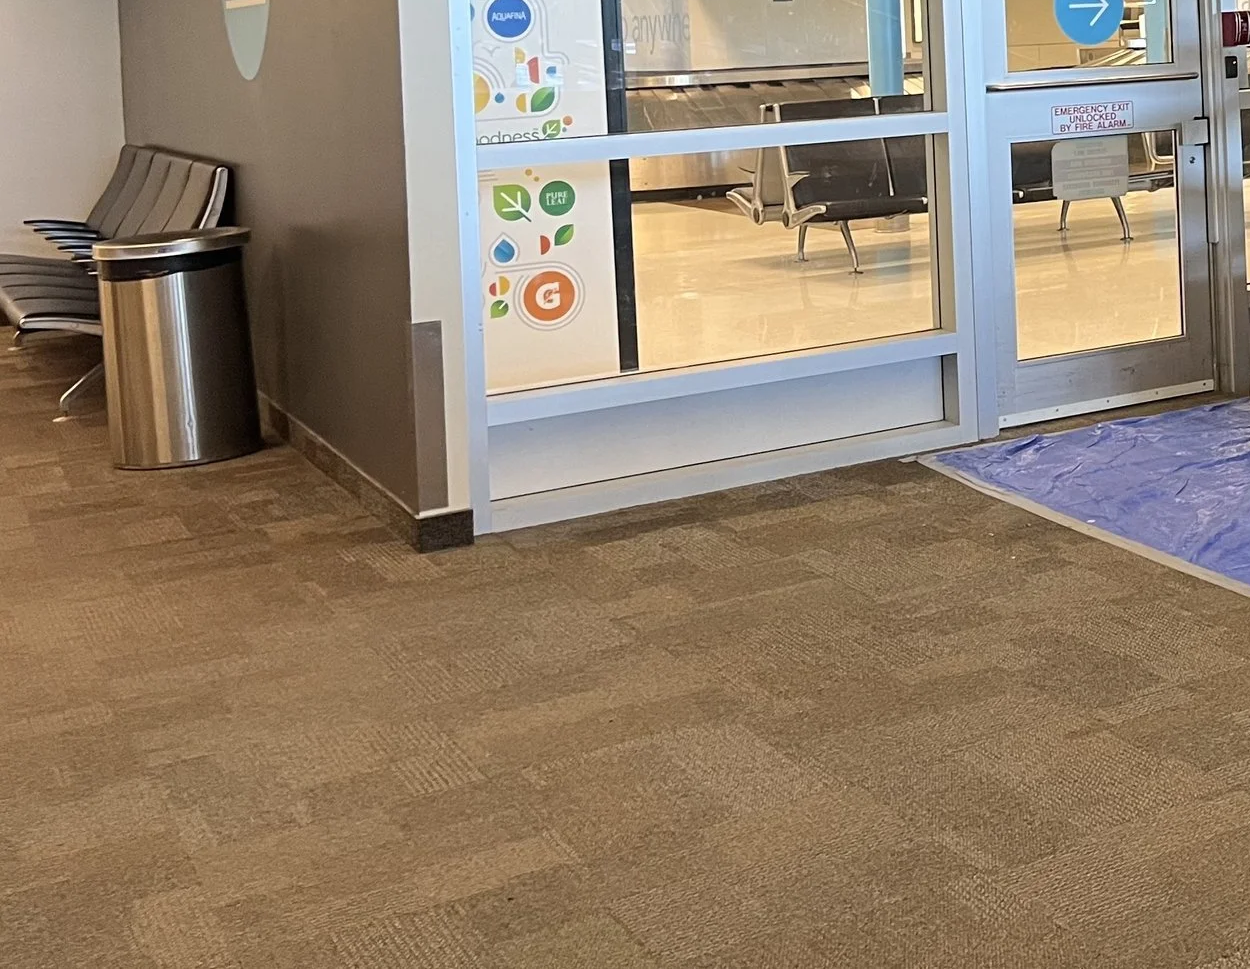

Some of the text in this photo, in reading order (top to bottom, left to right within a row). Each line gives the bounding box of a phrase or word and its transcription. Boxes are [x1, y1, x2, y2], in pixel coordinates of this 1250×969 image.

[491, 11, 527, 22] AQUAFINA
[1054, 103, 1130, 116] EMERGENCY EXIT
[1069, 112, 1117, 124] UNLOCKED
[1060, 119, 1127, 132] BY FIRE ALARM
[546, 191, 568, 200] PURE
[535, 281, 561, 310] G
